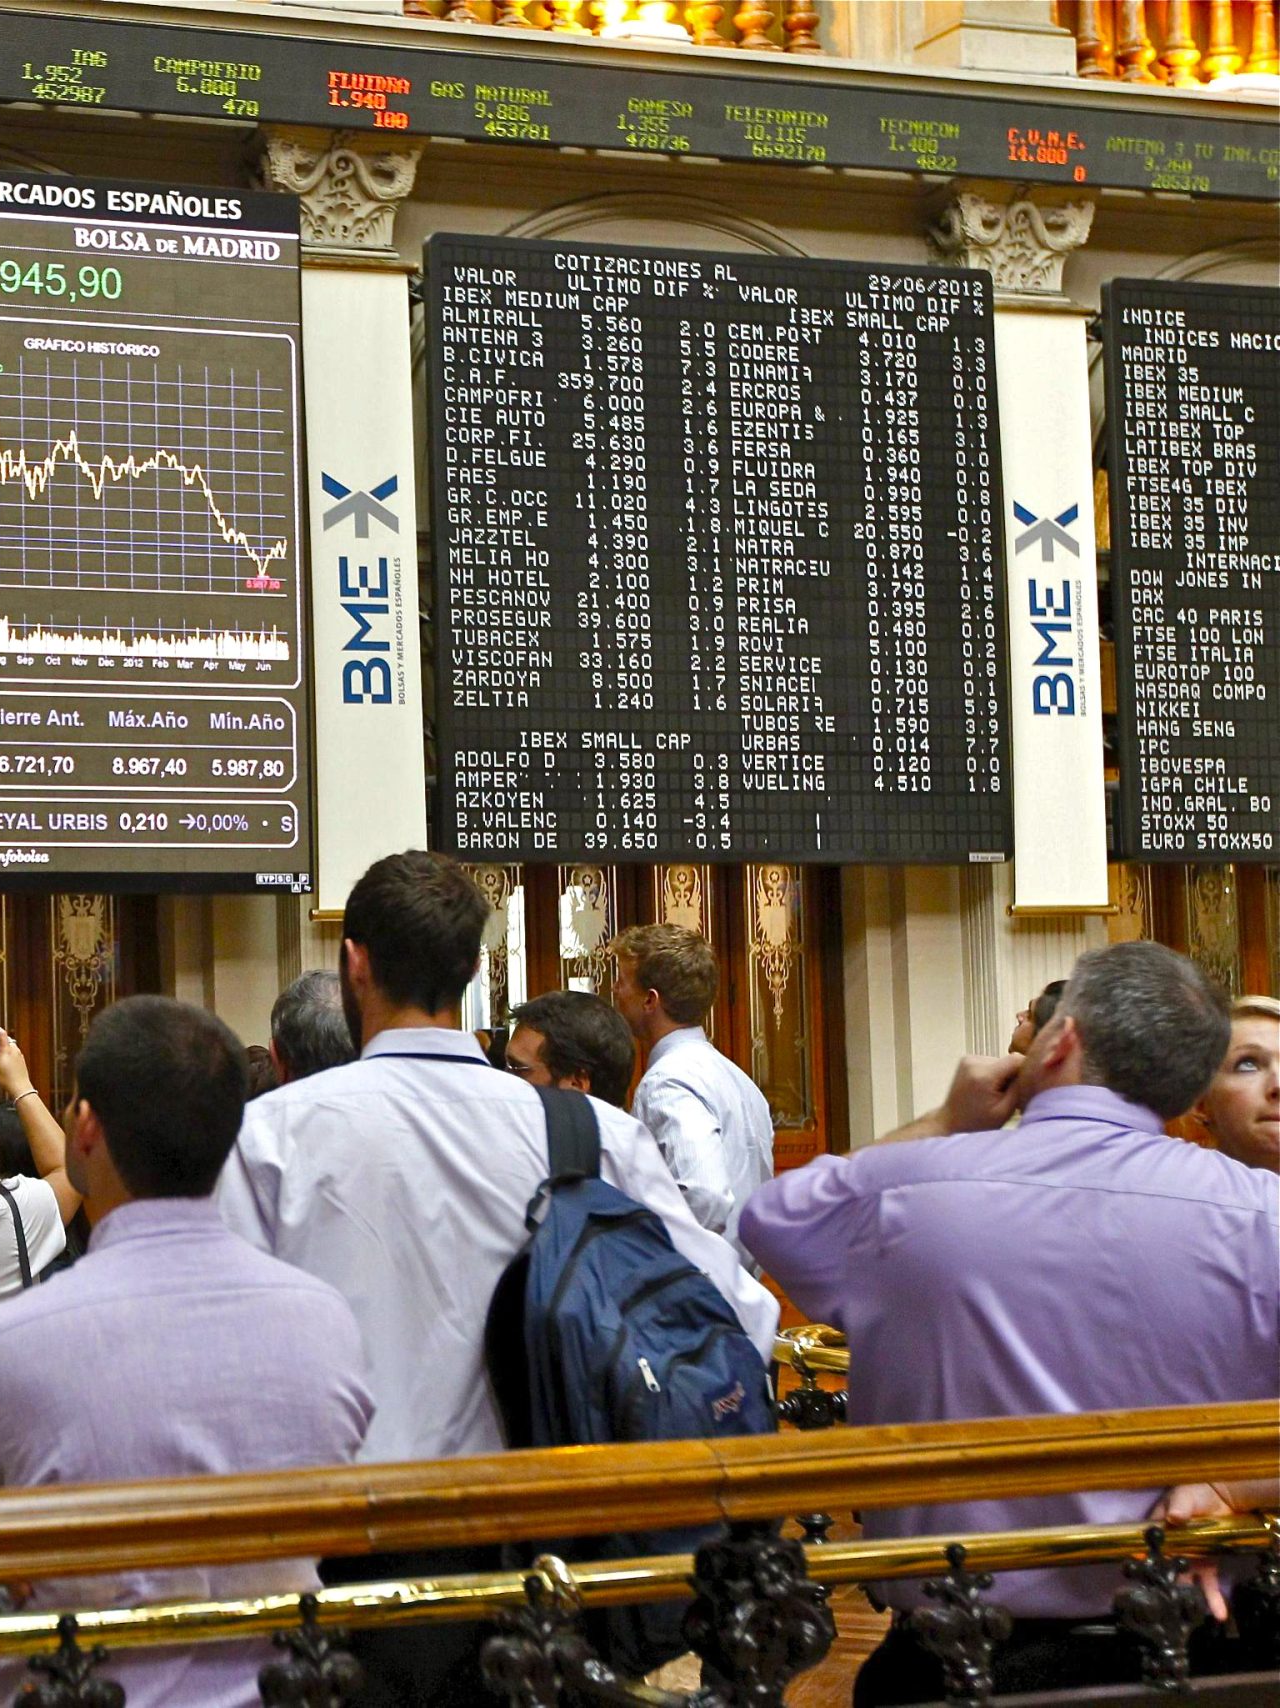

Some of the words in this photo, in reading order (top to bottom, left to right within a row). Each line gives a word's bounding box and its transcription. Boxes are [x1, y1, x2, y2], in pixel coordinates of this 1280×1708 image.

[21, 63, 83, 84] 1.952
[107, 188, 242, 221] ESPAÑOLES
[74, 228, 151, 251] BOLSA
[182, 236, 280, 260] MADRID
[555, 254, 701, 278] COTIZACIONES
[715, 264, 737, 281] AL
[869, 275, 982, 296] 29/06/2012
[739, 285, 797, 304] VALOR
[846, 292, 914, 311] ULTIMO
[928, 297, 960, 314] DIF
[443, 306, 542, 327] ALMIRALL
[582, 315, 641, 333] 5.560
[680, 321, 714, 337] 2.0
[1122, 346, 1187, 363] MADRID
[1125, 364, 1165, 381] IBEX
[1178, 367, 1198, 383] 35
[730, 382, 800, 400] ERCROS
[861, 389, 917, 406] 0.437
[1125, 383, 1166, 400] IBEX
[1179, 385, 1243, 403] MEDIUM
[1125, 420, 1200, 438] LATIBEX
[1213, 424, 1244, 440] TOP
[447, 467, 496, 484] FAES
[588, 473, 646, 491] 1.190
[687, 478, 719, 494] 1.7
[449, 528, 535, 546] JAZZTEL
[588, 533, 648, 550] 4.390
[393, 557, 403, 608] ESPAÑOLES
[737, 577, 783, 594] PRIM
[1132, 589, 1163, 604] DAX
[1133, 607, 1164, 623] CAC
[1177, 608, 1197, 624] 40
[1210, 609, 1262, 626] PARIS
[339, 556, 392, 704] BME
[739, 636, 783, 653] ROVI
[1028, 579, 1075, 715] BME
[17, 655, 34, 665] Sep
[45, 656, 60, 665] Oct
[72, 657, 88, 665] Nov
[98, 657, 114, 666] Dec
[123, 658, 143, 667] 2012
[153, 659, 169, 668] Feb
[177, 660, 193, 668] Mar
[203, 661, 219, 670] Apr
[229, 661, 246, 671] May
[256, 662, 271, 671] Jun
[452, 650, 552, 667] VISCOFAN
[740, 656, 821, 673] SERVICE
[47, 710, 84, 726] Ant.
[109, 710, 188, 728] Máx.Año
[1137, 701, 1199, 717] NIKKEI
[1137, 720, 1179, 736] HANG
[1193, 721, 1234, 737] SENG
[113, 758, 187, 778] 8.967,40
[212, 759, 284, 779] 5.987,80
[1140, 758, 1225, 774] IBOVESPA
[743, 774, 824, 790] VUELING
[1142, 777, 1182, 792] IGPA
[1195, 777, 1247, 793] CHILE
[49, 814, 107, 830] URBIS
[120, 813, 168, 833] 0,210
[197, 815, 248, 833] 0,00%
[1142, 814, 1194, 830] STOXX
[1207, 815, 1227, 830] 50
